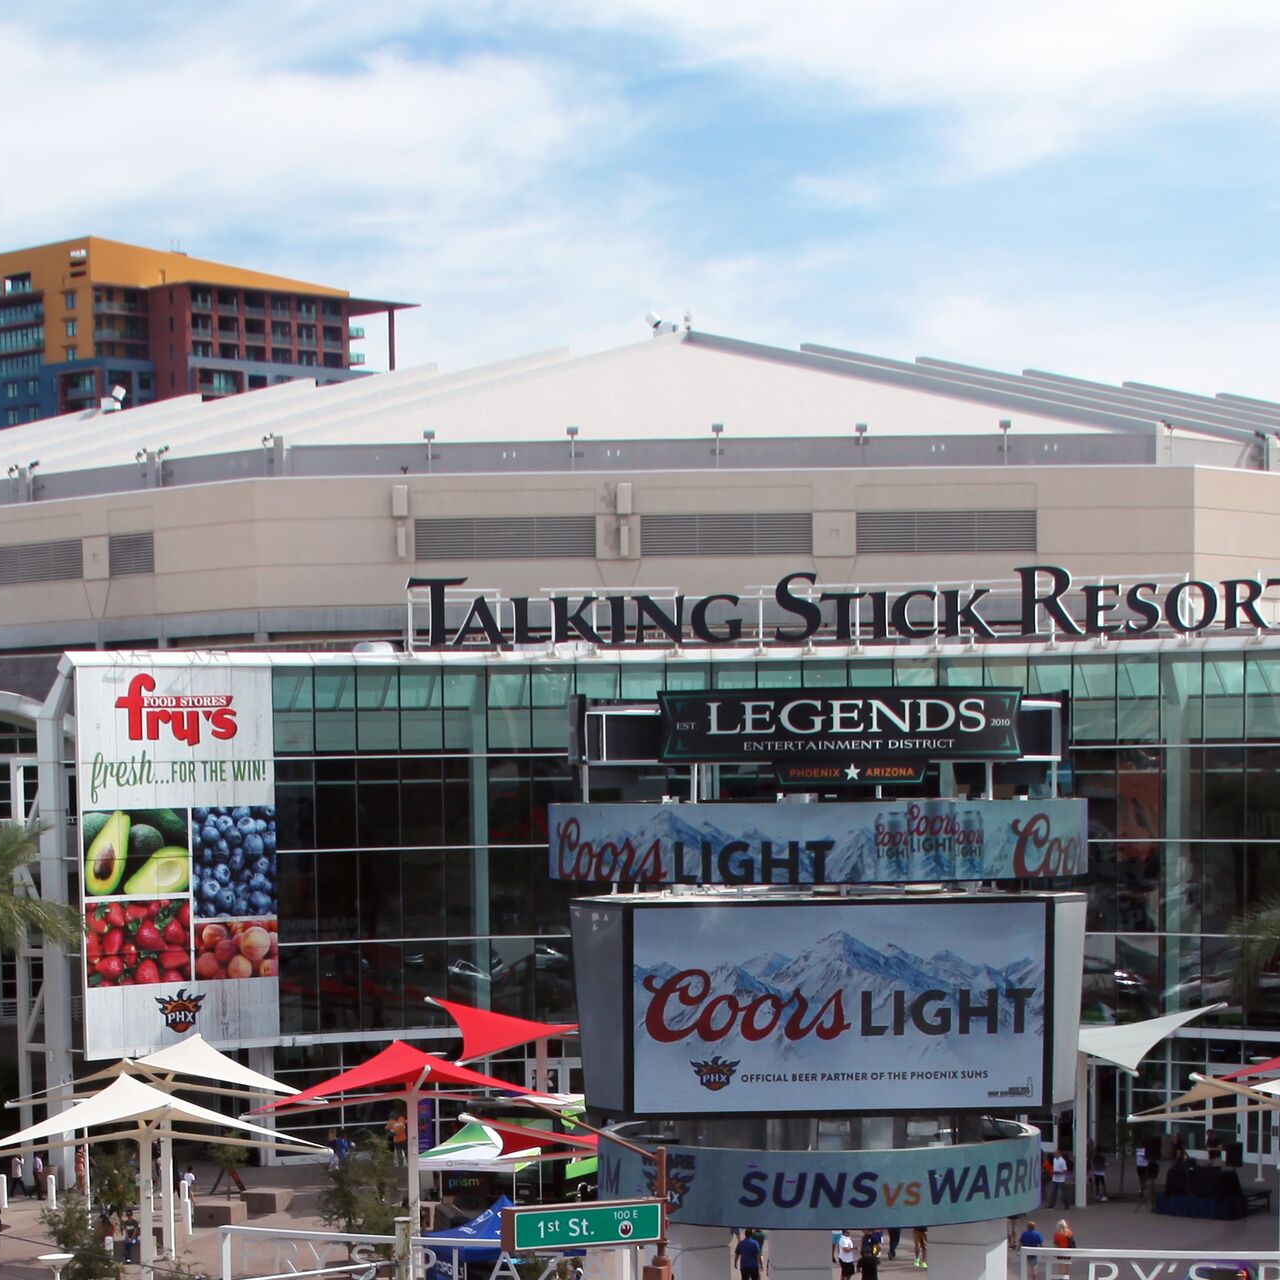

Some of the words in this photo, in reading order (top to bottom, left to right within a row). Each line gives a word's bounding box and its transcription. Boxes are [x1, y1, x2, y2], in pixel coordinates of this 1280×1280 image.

[407, 577, 741, 646] TALKING
[775, 573, 1000, 643] STICK
[144, 697, 176, 706] FOOD
[181, 696, 226, 706] STORES
[115, 673, 238, 746] fry's
[706, 699, 986, 735] LEGENDS
[990, 718, 1011, 728] 2010
[743, 739, 883, 751] ENTERTAINMENT
[888, 738, 955, 749] DISTRICT
[171, 760, 196, 782] FOR
[201, 760, 227, 782] THE
[232, 759, 266, 782] WIN!
[789, 768, 840, 778] PHOENIX
[865, 767, 914, 777] ARIZONA
[557, 817, 667, 882] Coors
[675, 839, 835, 885] LIGHT
[910, 837, 952, 852] LIGHT
[643, 969, 851, 1042] Coors
[860, 988, 1036, 1037] LIGHT
[166, 1010, 194, 1025] PHX
[701, 1073, 729, 1085] PHX
[741, 1073, 788, 1083] OFFICIAL
[791, 1073, 817, 1082] BEER
[821, 1072, 868, 1082] PARTNER
[871, 1072, 885, 1081] OF
[888, 1071, 907, 1081] THE
[910, 1070, 958, 1080] PHOENIX
[961, 1070, 988, 1079] SUNS
[448, 1178, 480, 1189] prism
[741, 1171, 879, 1209] SUNS
[613, 1211, 630, 1220] 100
[632, 1210, 638, 1218] E
[538, 1219, 560, 1238] 1st
[568, 1218, 595, 1237] St.
